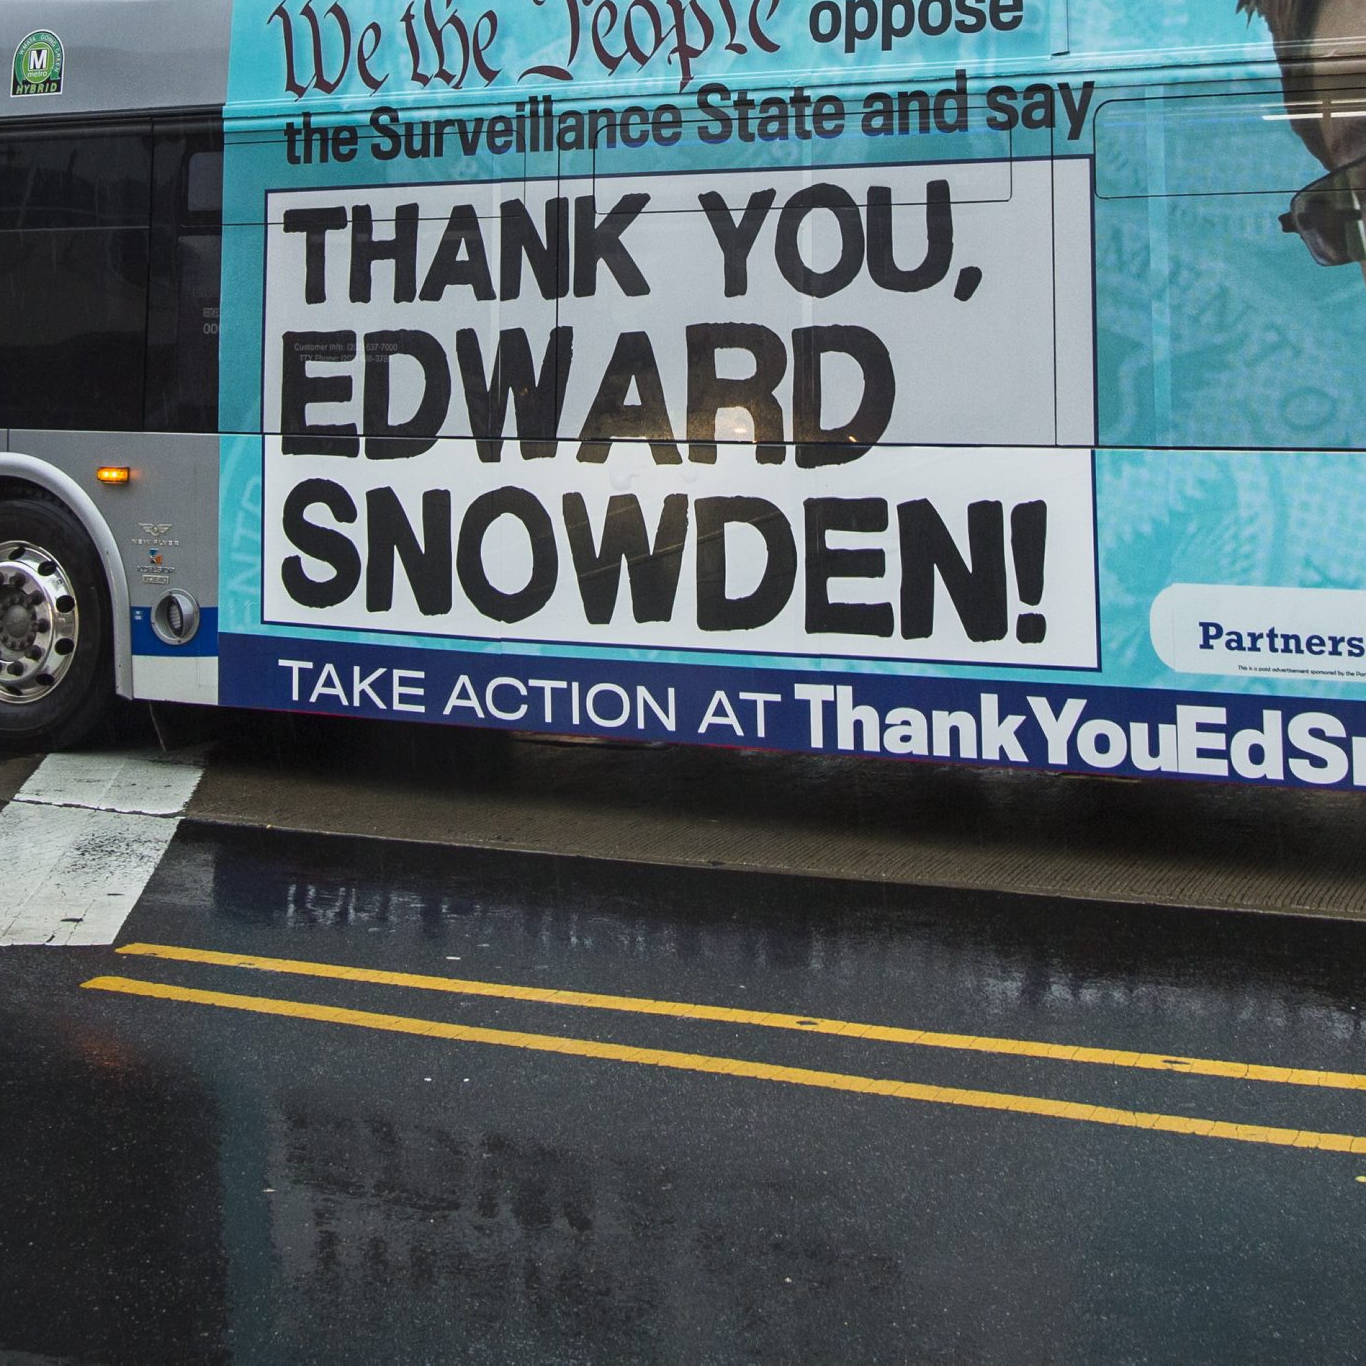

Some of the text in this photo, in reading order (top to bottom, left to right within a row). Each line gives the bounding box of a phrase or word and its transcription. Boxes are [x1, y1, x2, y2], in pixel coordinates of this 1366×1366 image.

[16, 83, 58, 94] HYBRID
[284, 69, 1096, 165] the Surveillance State and say
[282, 190, 651, 308] THANK
[695, 179, 984, 302] YOU,
[281, 322, 896, 469] EDWARD
[294, 343, 327, 353] Customer
[282, 478, 1047, 643] SNOWDEN!
[278, 659, 426, 713] TAKE
[442, 674, 676, 732] ACTION
[697, 690, 782, 738] AT
